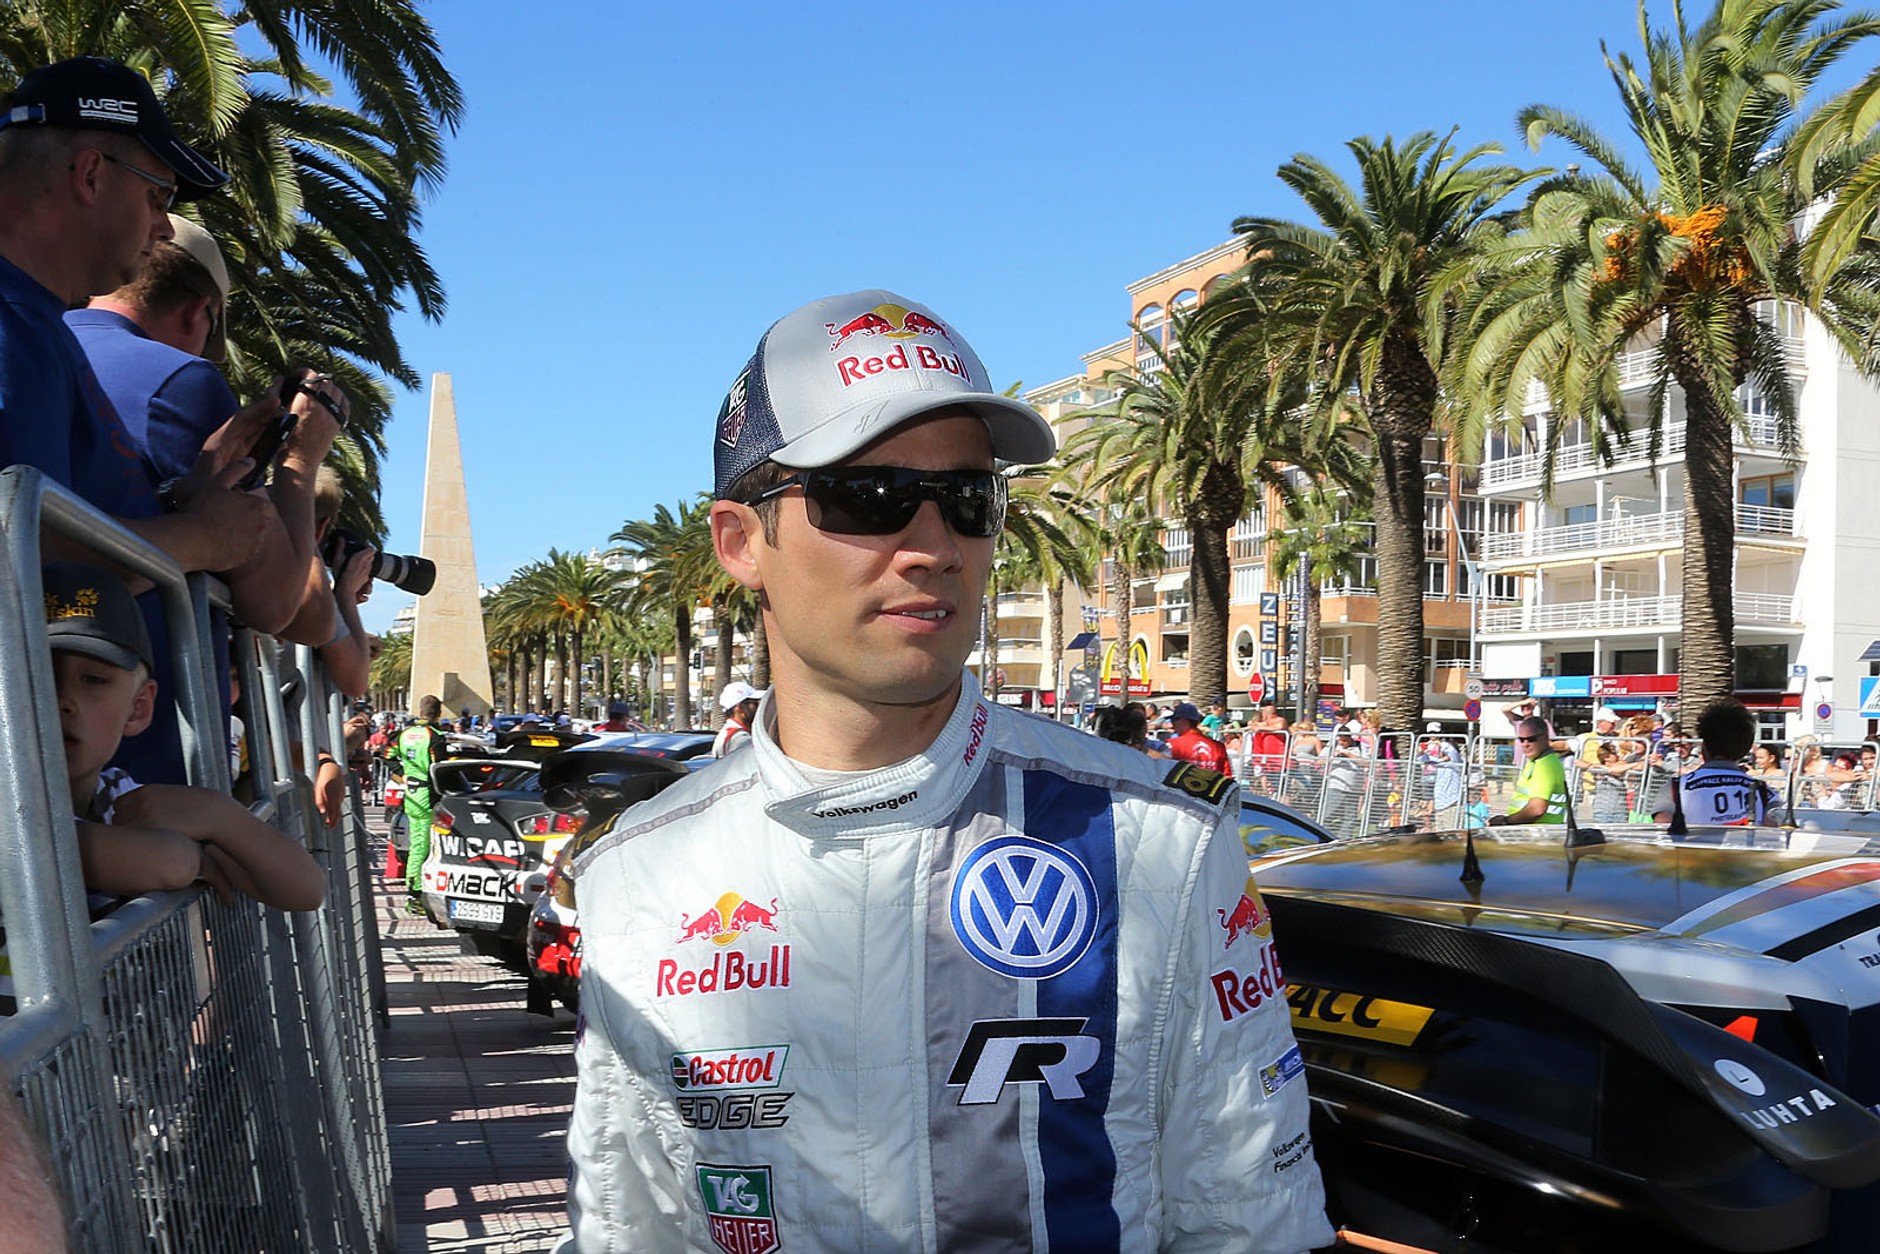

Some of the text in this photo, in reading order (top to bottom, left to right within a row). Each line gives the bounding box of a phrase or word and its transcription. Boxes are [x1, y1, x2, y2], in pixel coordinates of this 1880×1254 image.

[78, 97, 138, 114] WRC
[837, 343, 972, 387] Red Bull
[1262, 594, 1277, 699] ZEUS
[1468, 686, 1480, 694] 50
[813, 790, 918, 819] Volkswagen
[657, 945, 790, 997] Red Bull
[1211, 947, 1273, 1021] Red
[1286, 985, 1381, 1028] ACC
[690, 1051, 775, 1086] Castrol
[676, 1092, 795, 1130] EDGE
[1740, 1089, 1836, 1129] LUHTA
[707, 1174, 759, 1213] TAG
[713, 1219, 771, 1254] HEUER
